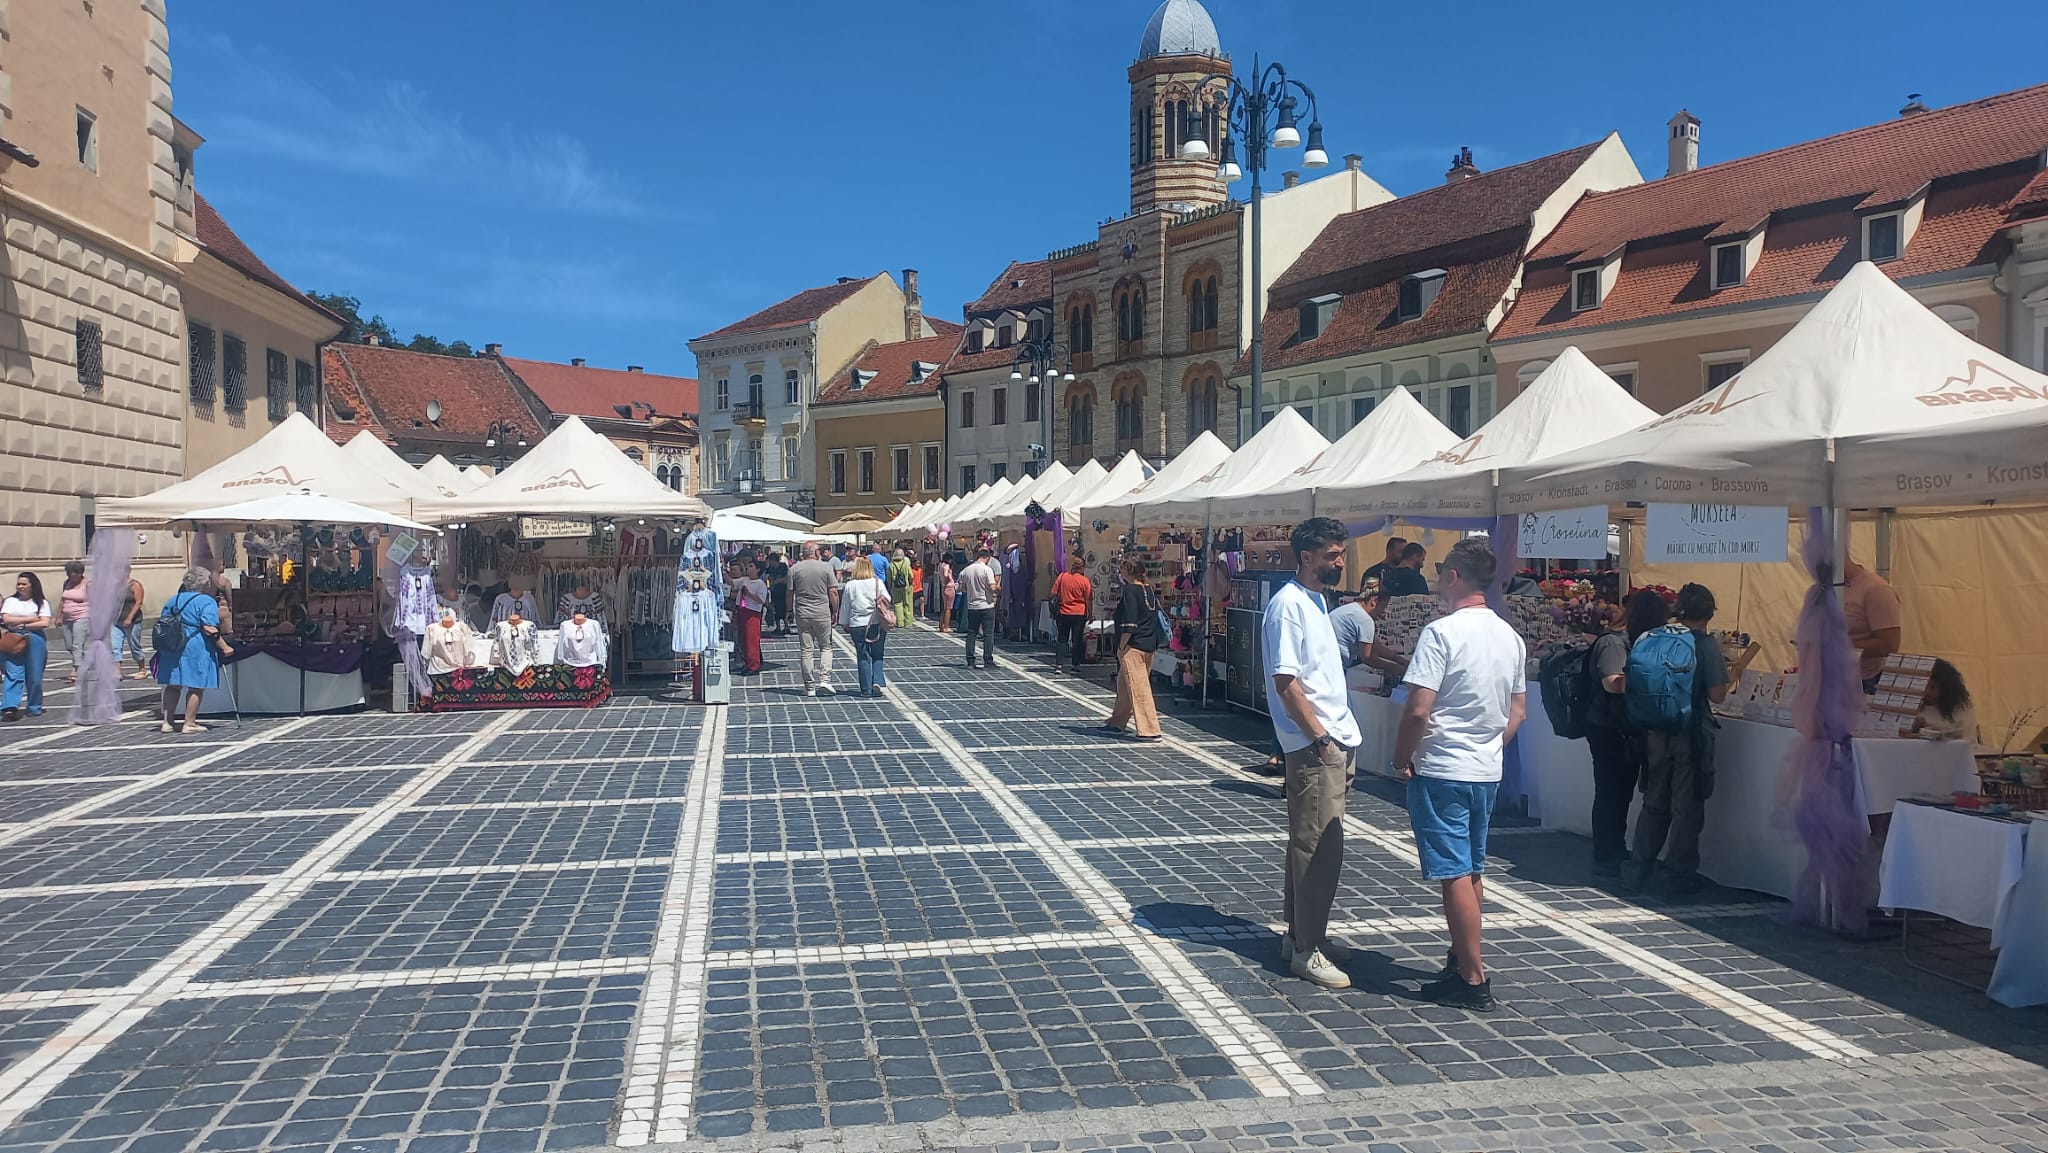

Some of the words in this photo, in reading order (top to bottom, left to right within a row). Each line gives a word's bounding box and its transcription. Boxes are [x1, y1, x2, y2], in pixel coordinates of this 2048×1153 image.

[1548, 484, 1589, 499] Kronstadt
[1655, 477, 1692, 491] Corona
[1711, 477, 1769, 493] Brassovia
[1895, 473, 1952, 493] Brașov
[1741, 541, 1761, 554] MORSE
